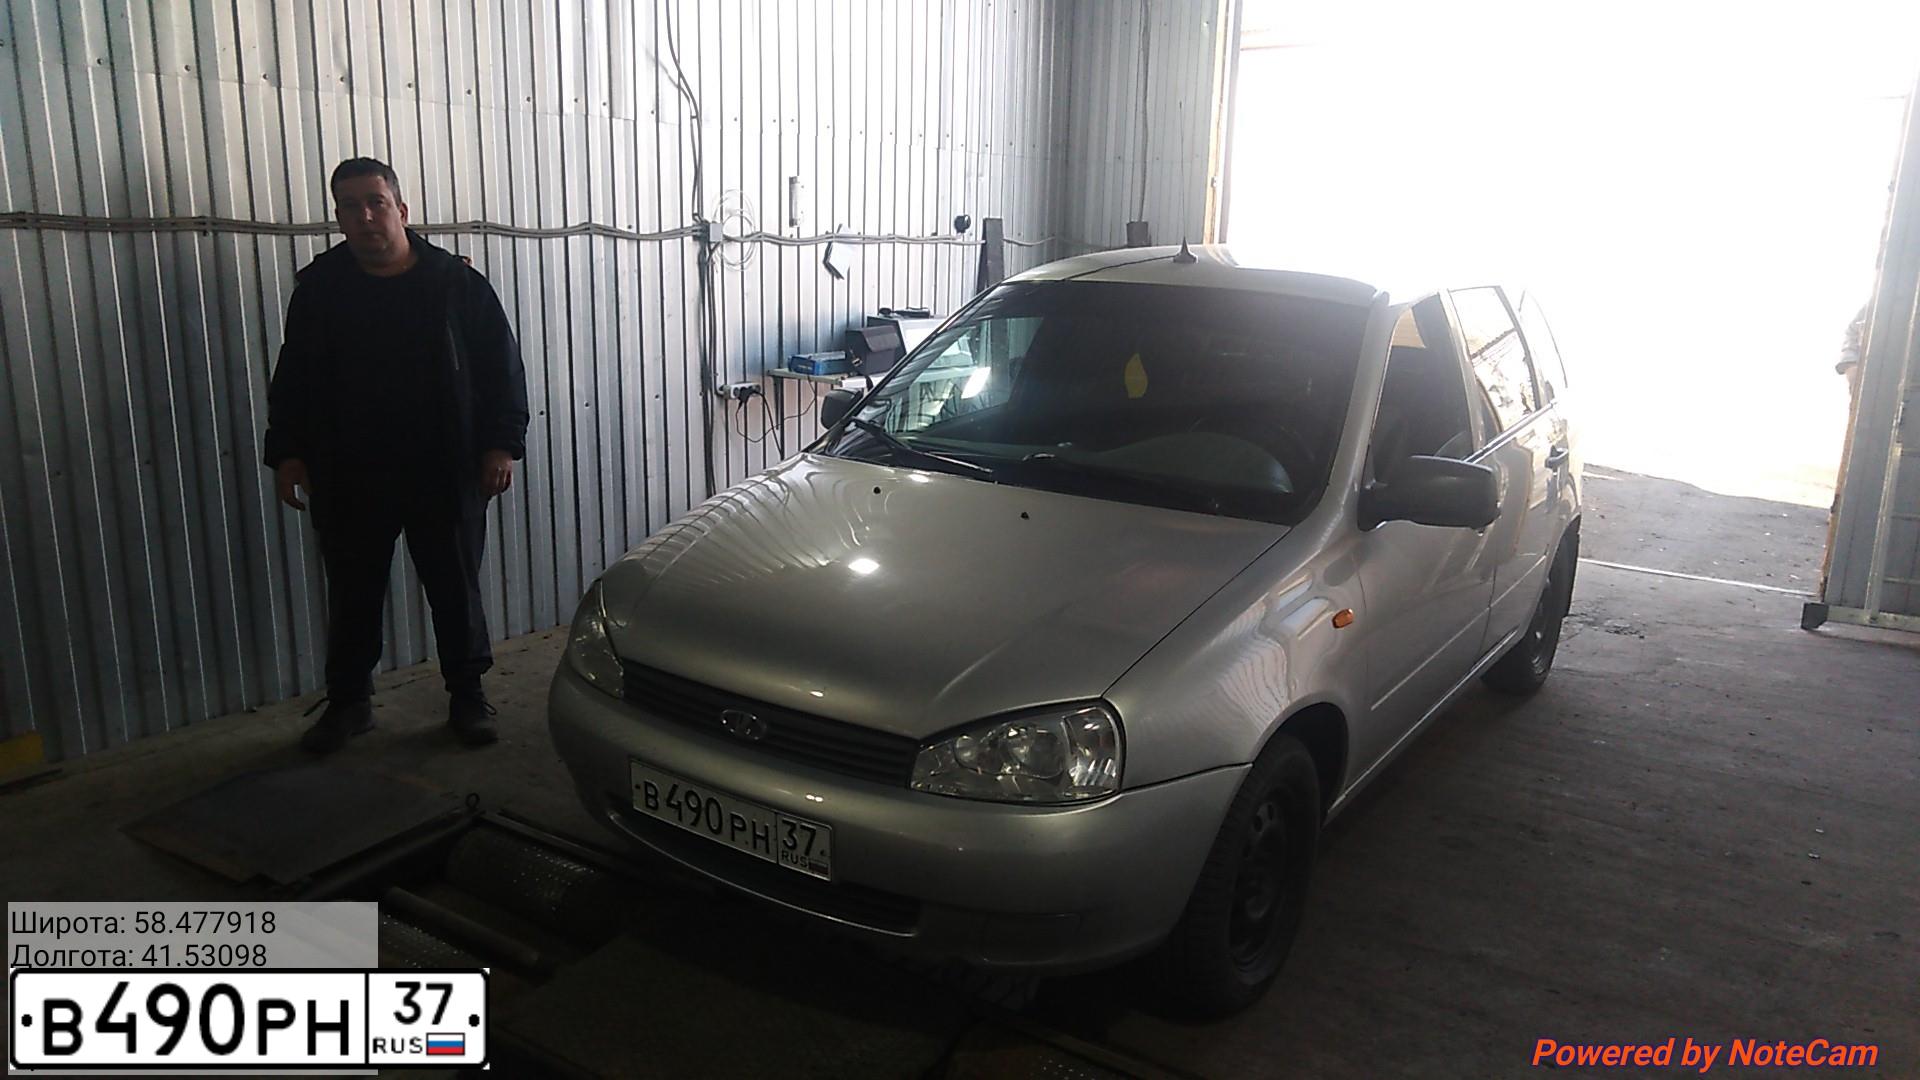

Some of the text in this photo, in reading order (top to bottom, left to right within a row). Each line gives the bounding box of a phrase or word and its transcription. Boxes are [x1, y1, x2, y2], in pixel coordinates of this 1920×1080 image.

[643, 779, 770, 855] В490РН
[781, 817, 816, 856] 37
[781, 850, 808, 869] RUS
